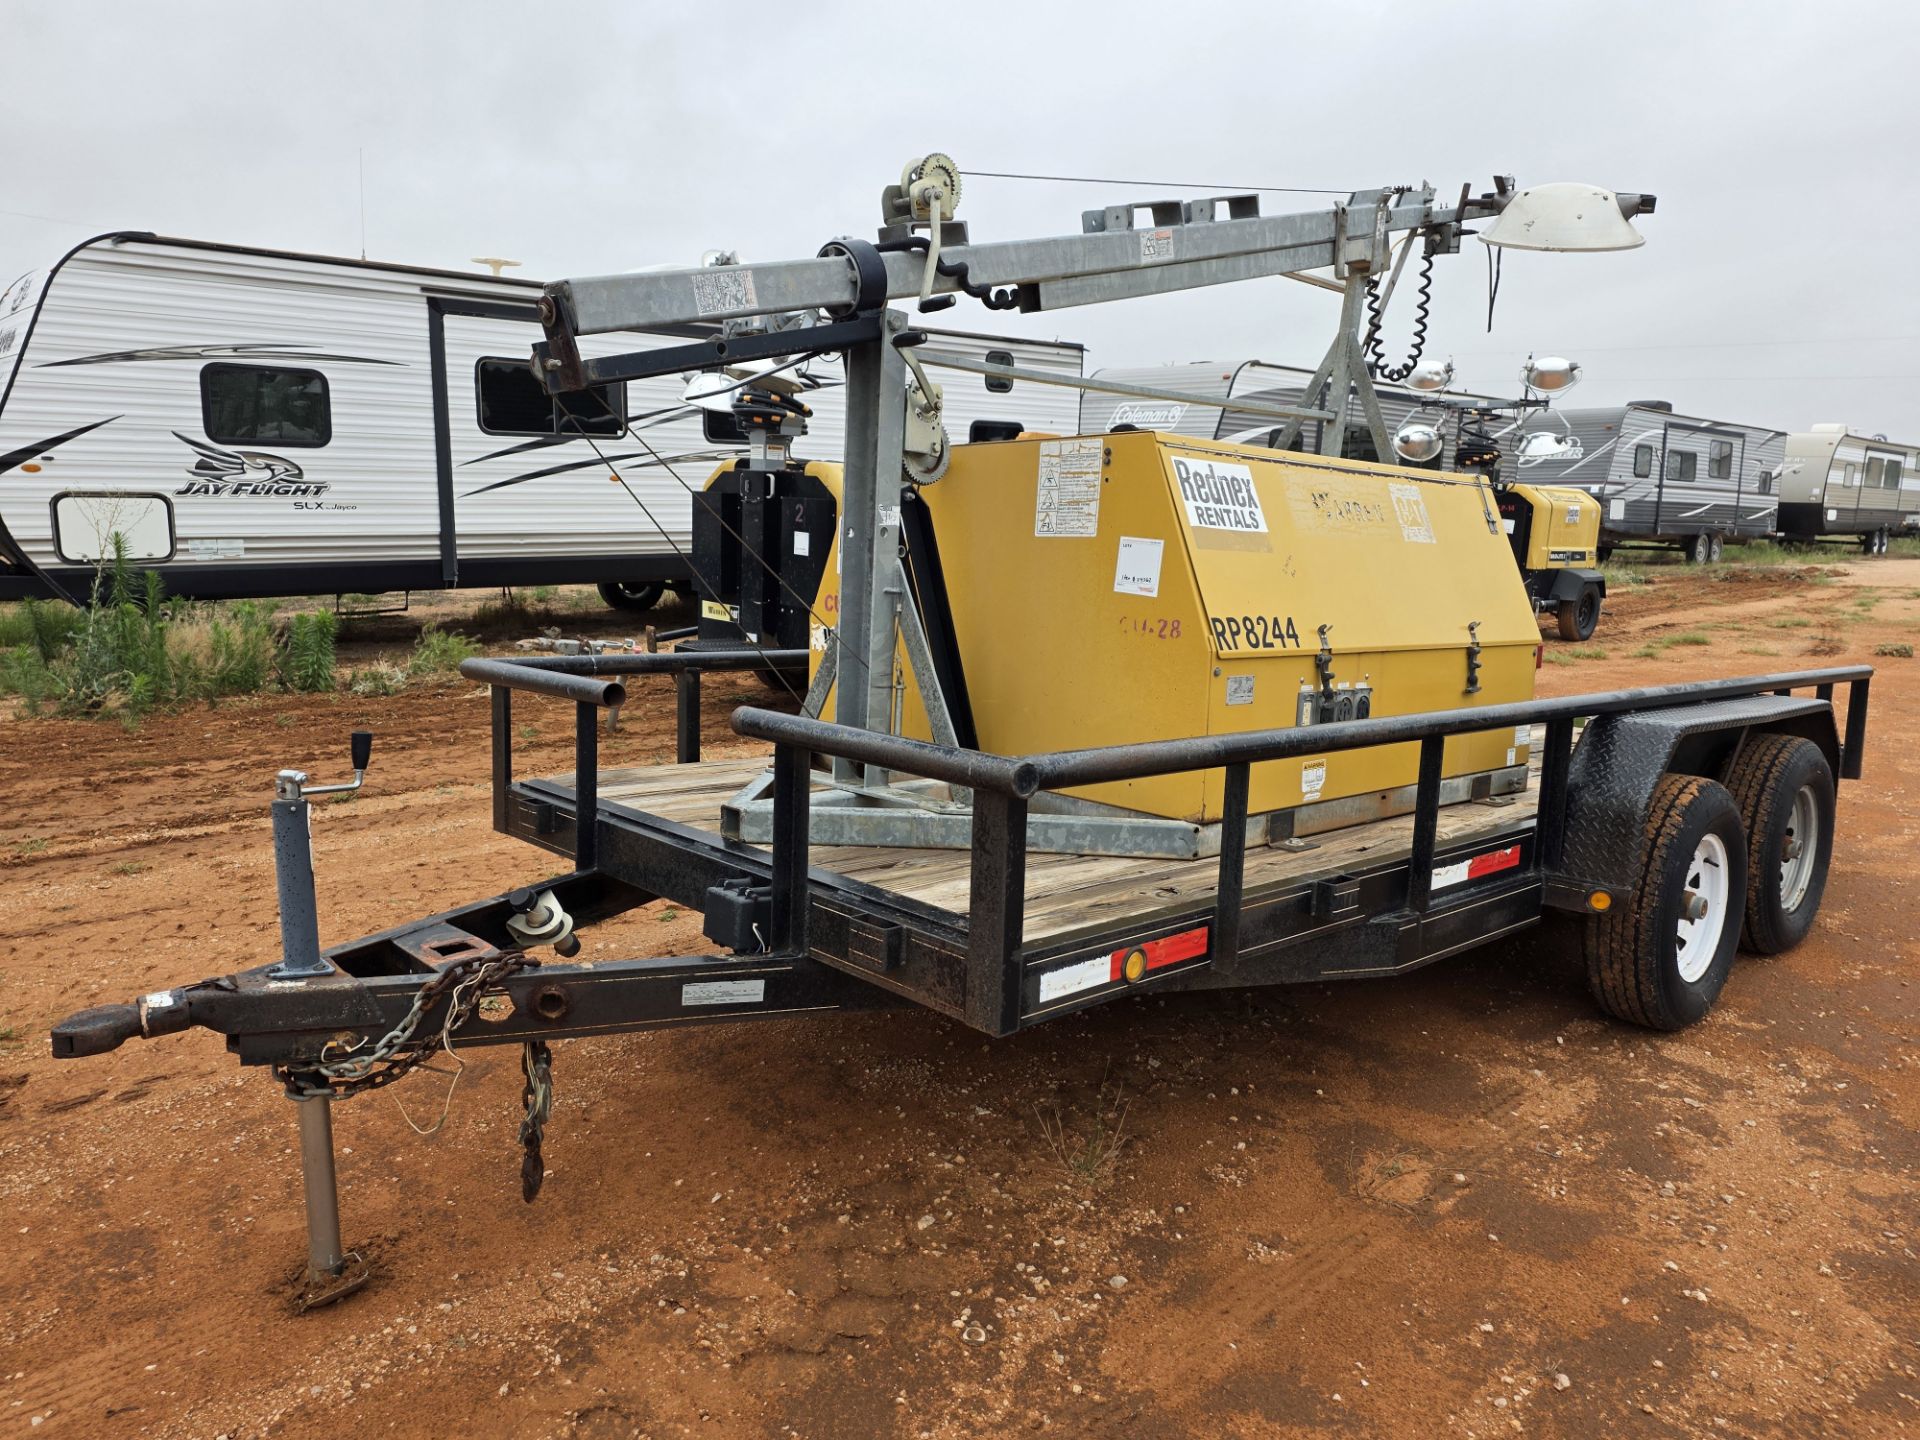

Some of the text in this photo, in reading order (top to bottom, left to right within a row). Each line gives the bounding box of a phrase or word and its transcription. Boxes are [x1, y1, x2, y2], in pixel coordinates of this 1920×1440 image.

[1115, 406, 1169, 424] Coleman
[175, 481, 329, 497] JAY FLIGHT
[1174, 459, 1259, 509] Rednex
[293, 501, 324, 511] SLX
[795, 504, 804, 522] 2
[1194, 505, 1260, 530] RENTALS
[1211, 615, 1300, 650] RP8244
